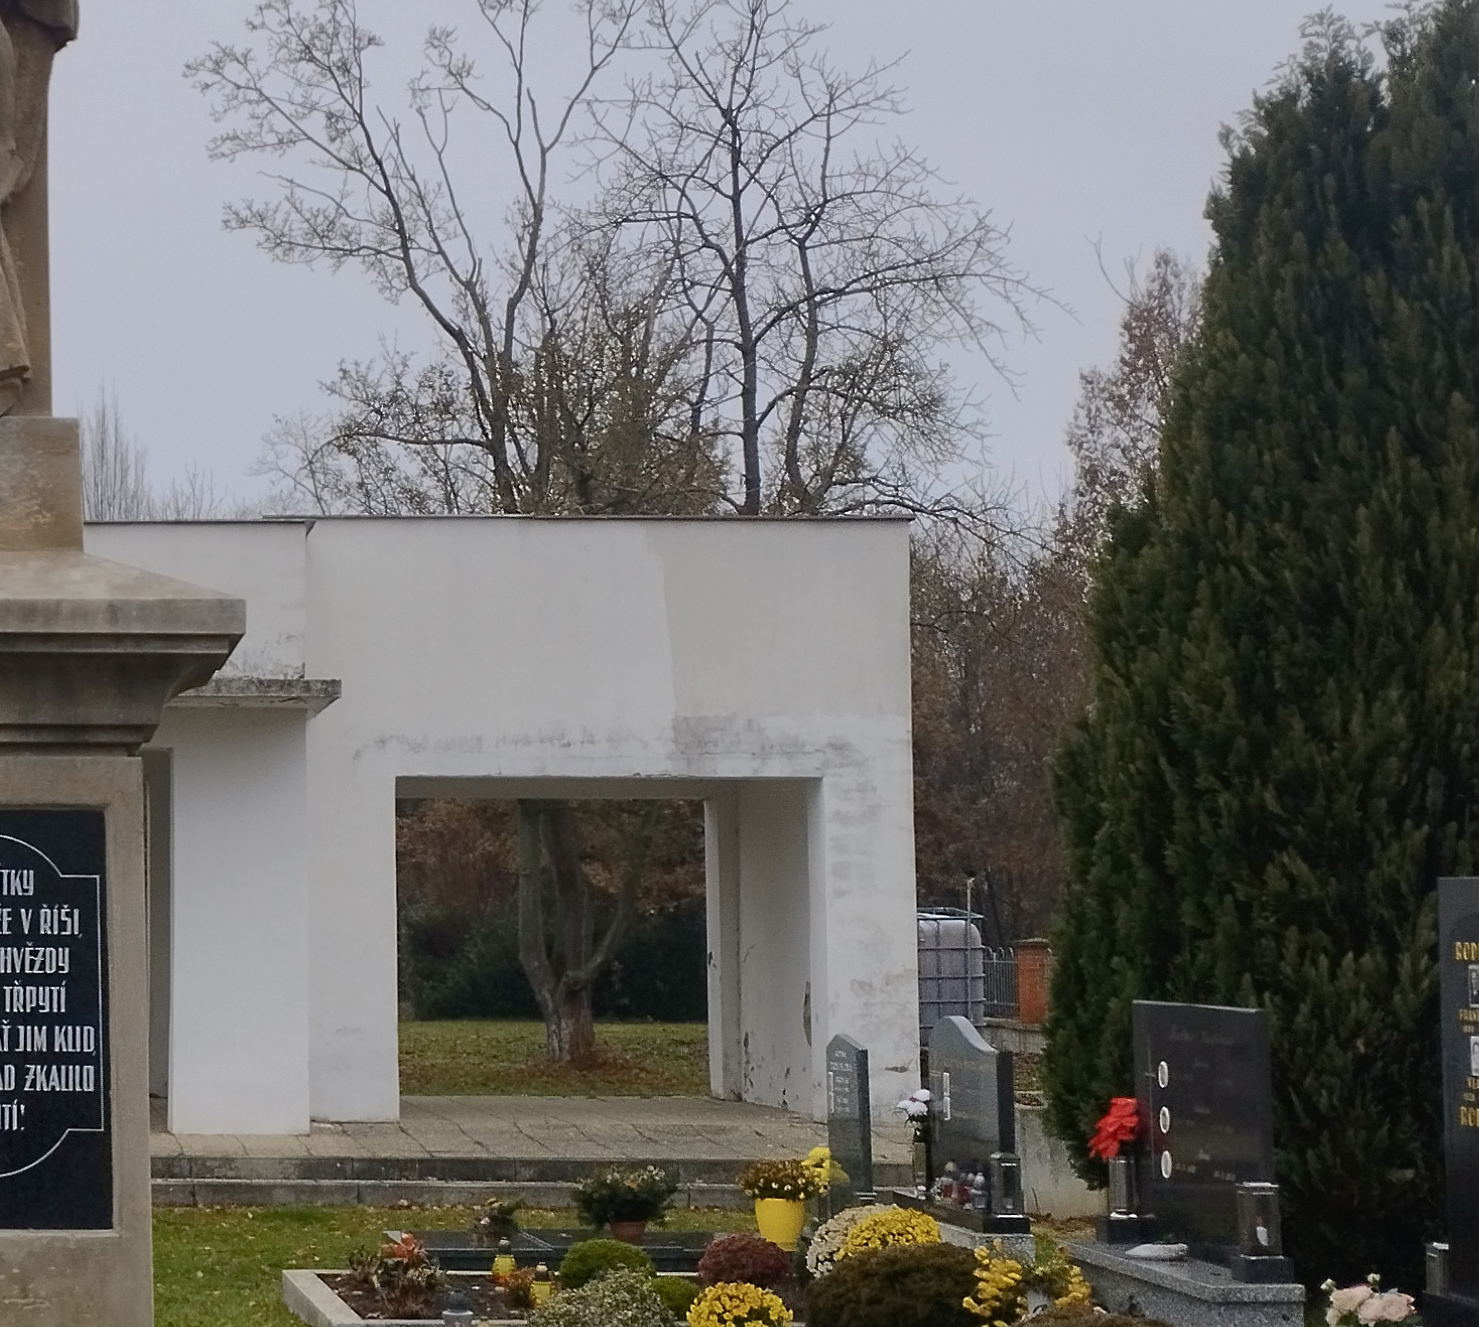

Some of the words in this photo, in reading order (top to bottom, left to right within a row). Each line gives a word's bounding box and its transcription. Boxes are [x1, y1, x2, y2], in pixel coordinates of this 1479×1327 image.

[20, 908, 33, 934] V
[39, 903, 83, 939] ŘÍŠI,
[0, 941, 70, 973] HVĚZDY
[3, 980, 67, 1013] TŘPYTÍ
[14, 1025, 47, 1052] JIM
[53, 1025, 97, 1057] KLID,
[23, 1064, 95, 1092] ZKALILO
